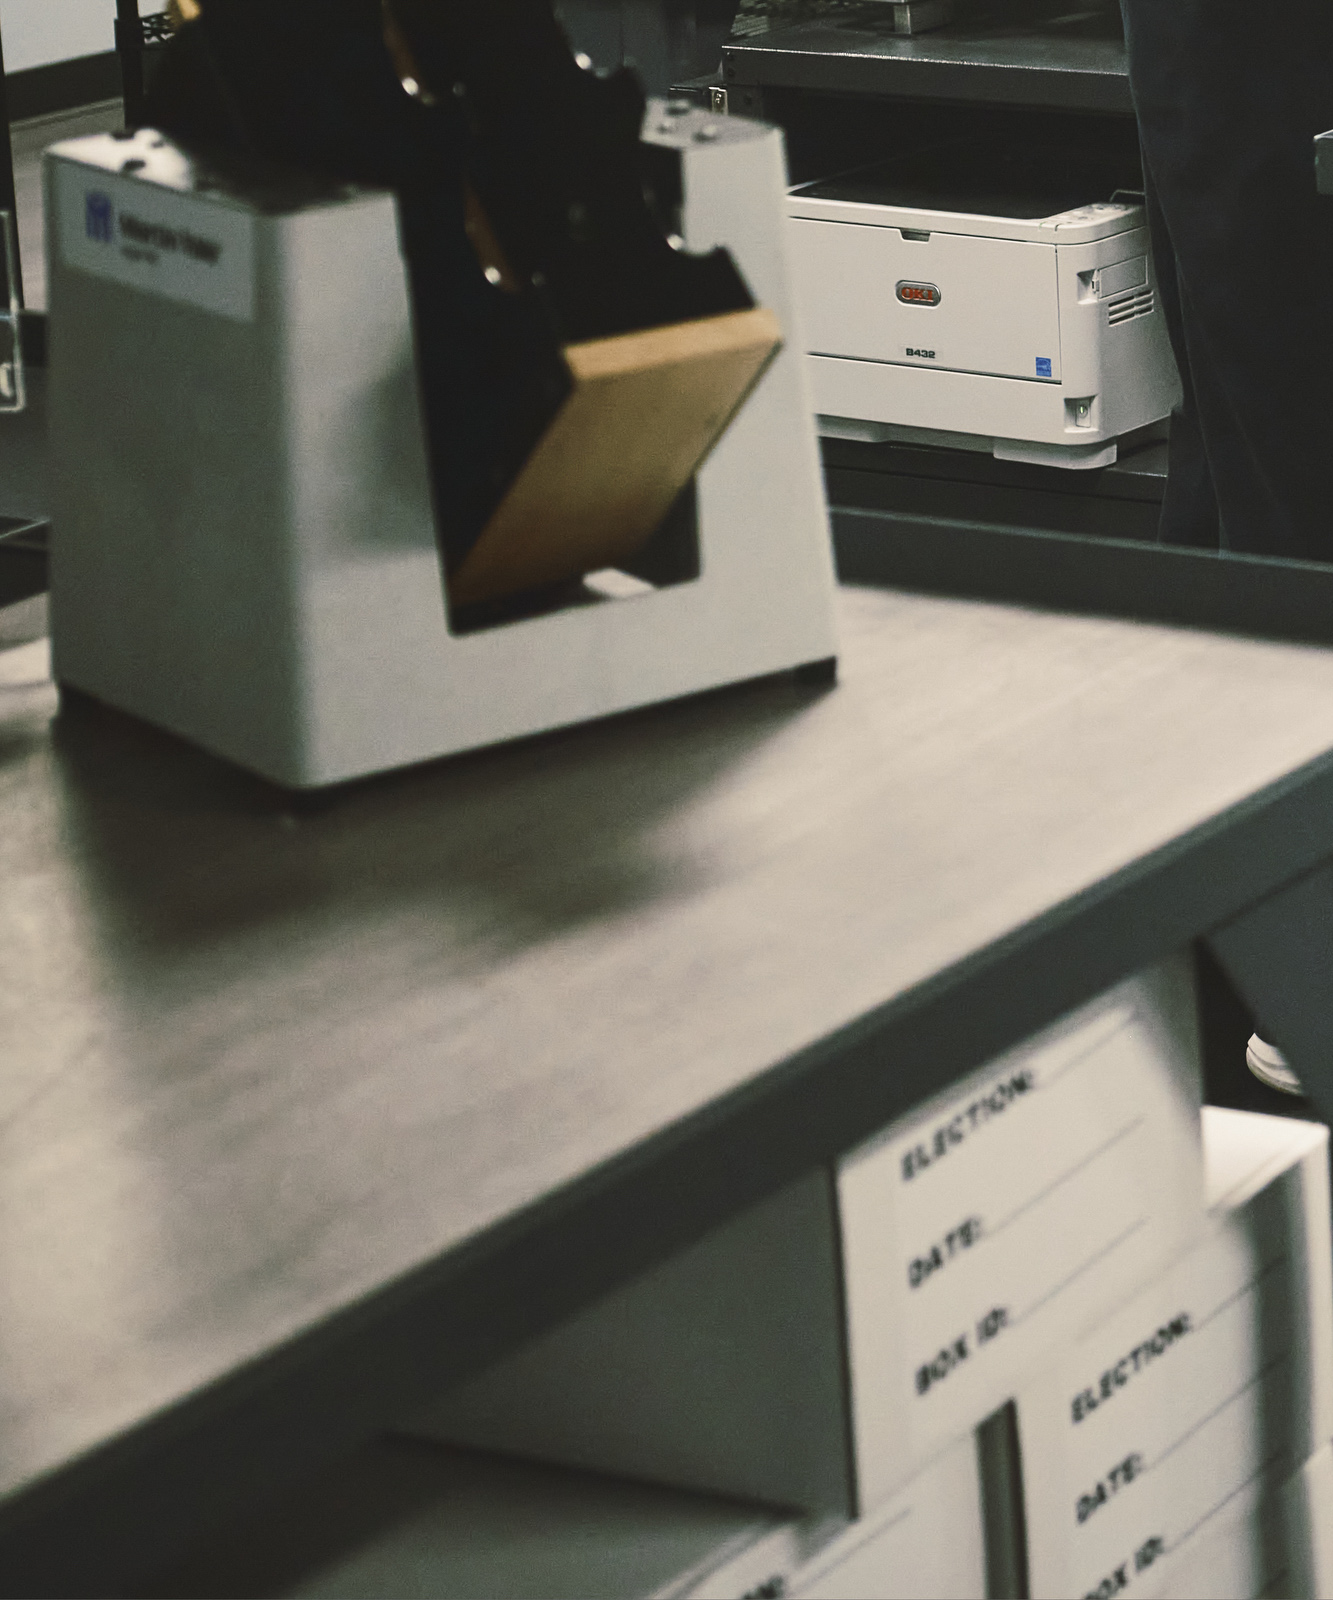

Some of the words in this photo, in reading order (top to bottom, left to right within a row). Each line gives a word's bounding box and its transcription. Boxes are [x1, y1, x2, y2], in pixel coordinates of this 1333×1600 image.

[901, 286, 935, 302] OKI
[905, 347, 936, 359] B432
[900, 1070, 1034, 1182] ELECTION:
[907, 1215, 981, 1290] DATE:
[914, 1332, 969, 1396] BOX
[975, 1306, 1008, 1347] ID:
[1070, 1311, 1192, 1426] ELECTION:
[1075, 1452, 1145, 1526] DATE:
